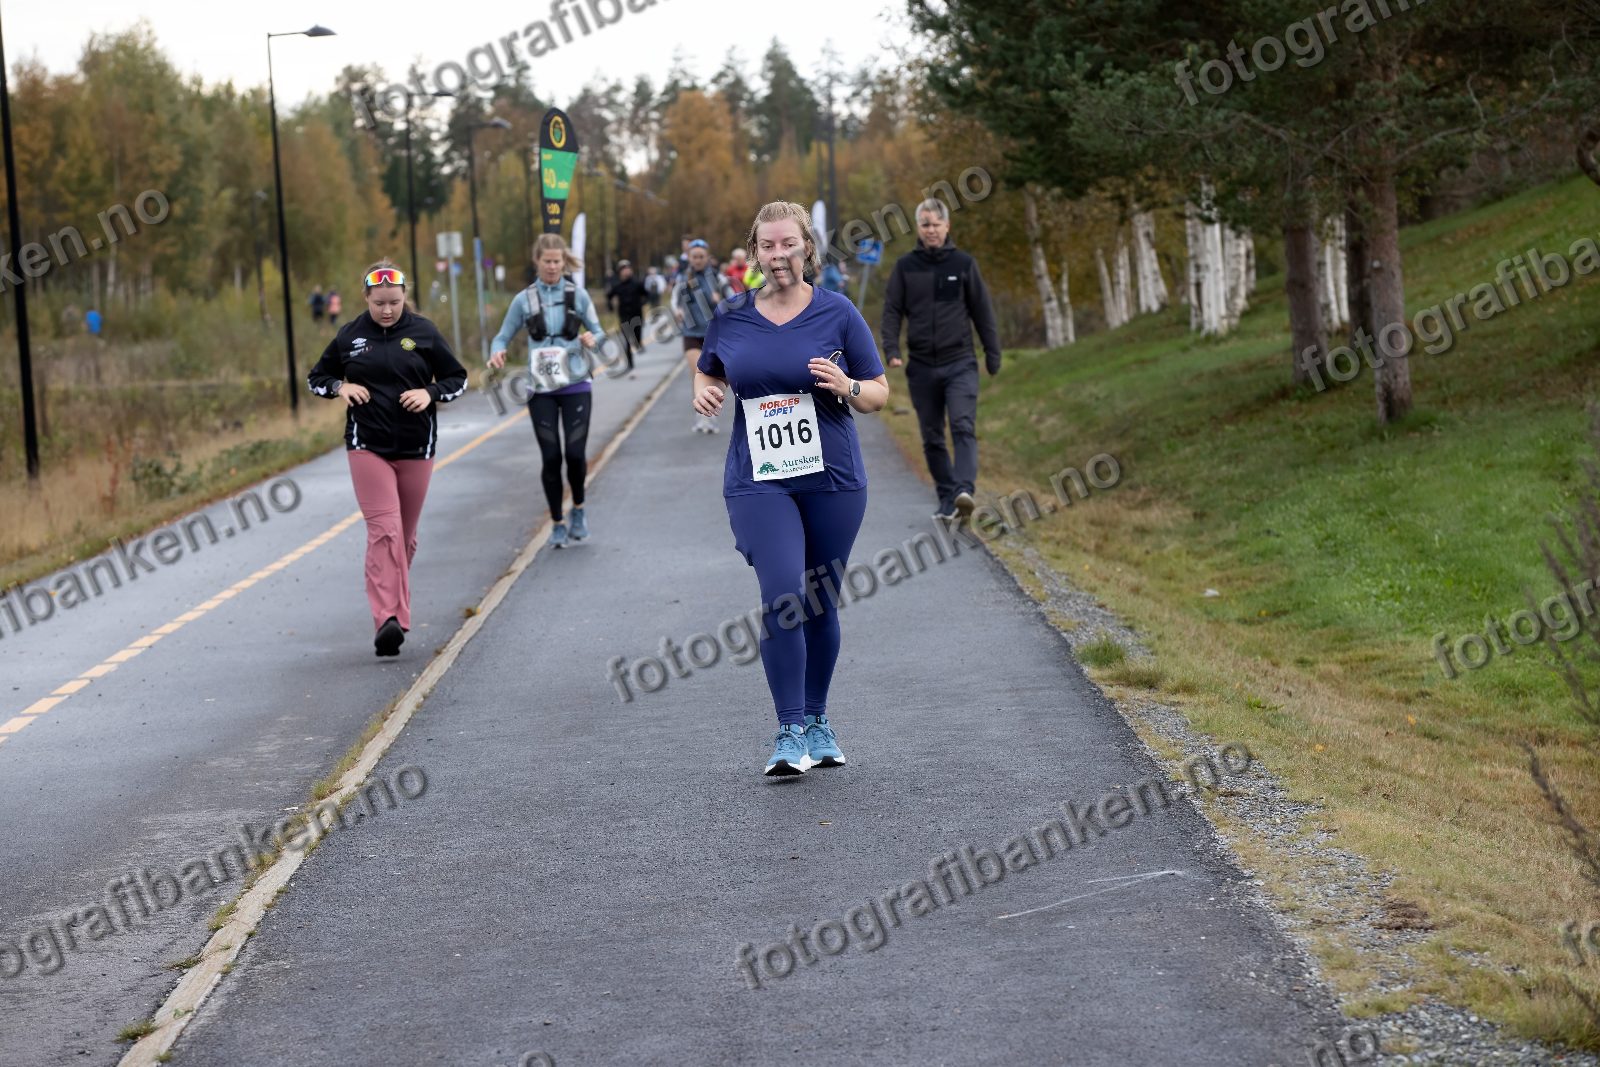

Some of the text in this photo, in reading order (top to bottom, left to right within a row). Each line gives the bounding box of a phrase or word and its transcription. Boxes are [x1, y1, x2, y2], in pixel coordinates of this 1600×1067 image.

[759, 397, 800, 411] NORGES
[763, 406, 794, 418] LØPET
[755, 418, 812, 451] 1016
[781, 455, 820, 468] Aurskog
